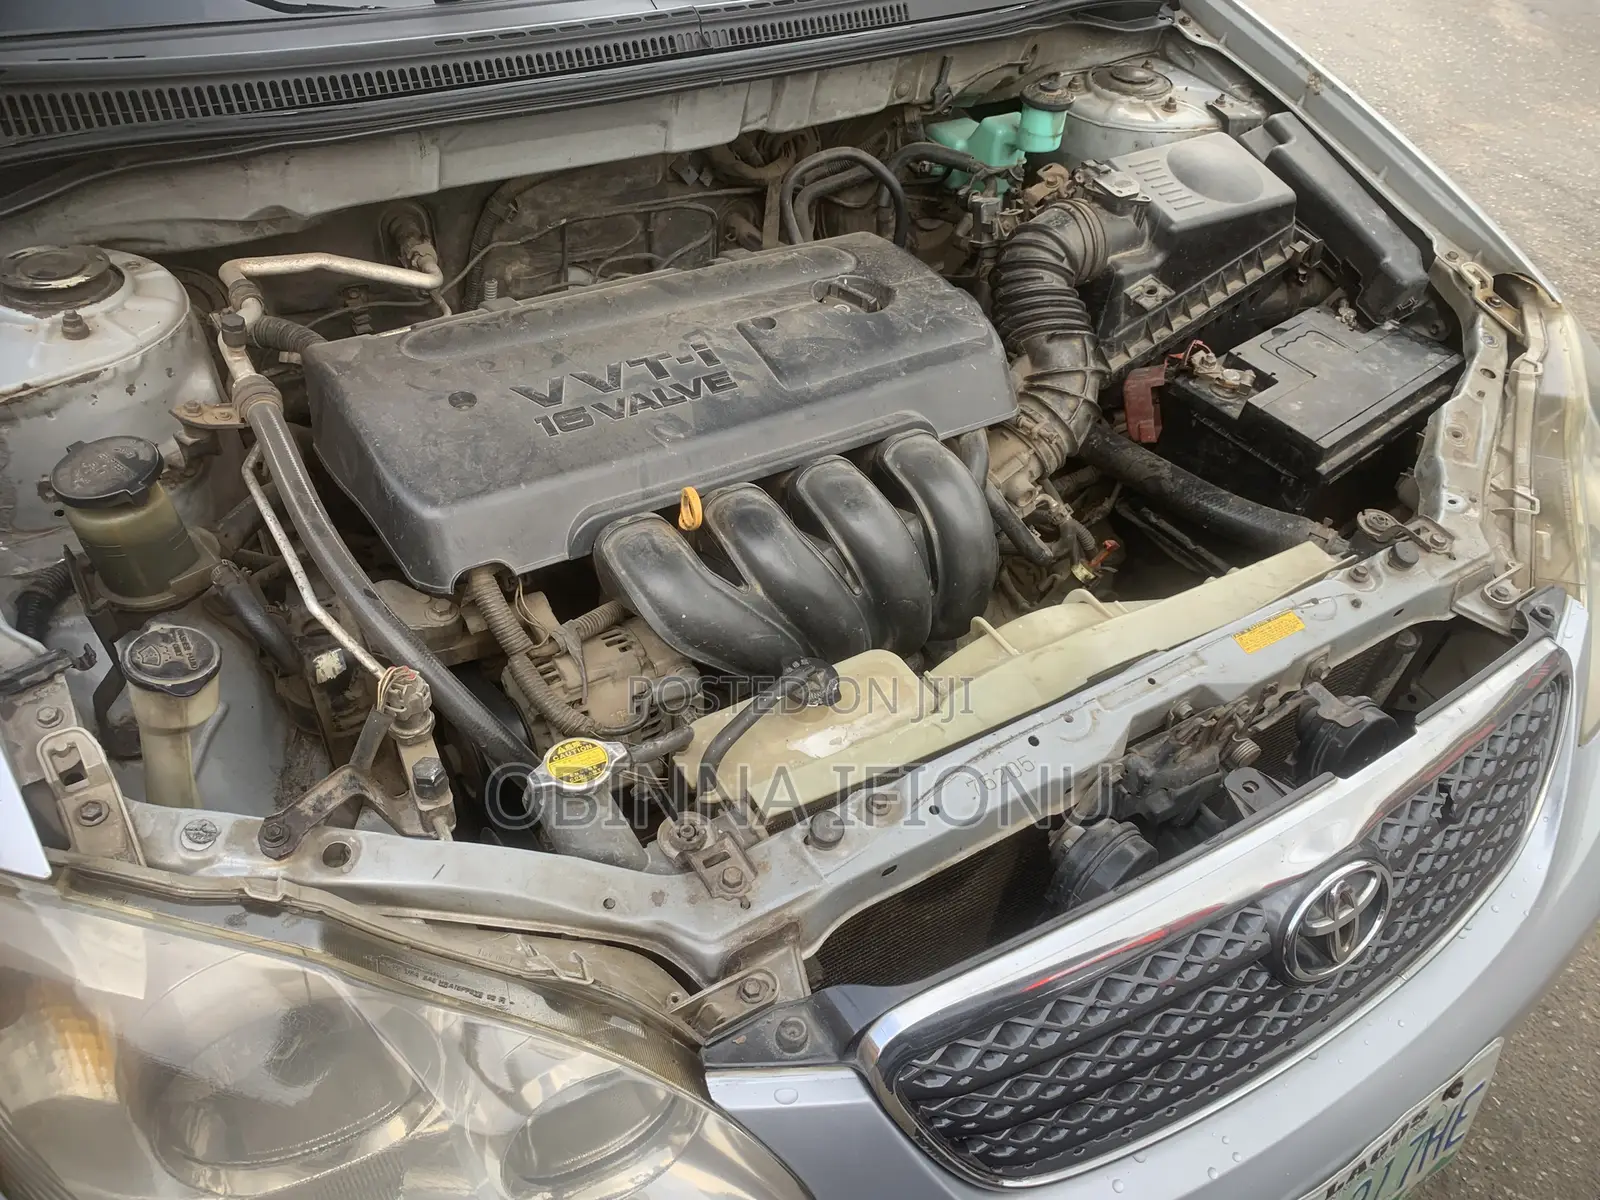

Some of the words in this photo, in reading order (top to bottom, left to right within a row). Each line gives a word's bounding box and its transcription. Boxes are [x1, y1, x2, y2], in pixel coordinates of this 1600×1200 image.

[509, 342, 722, 408] VVT-i
[533, 405, 596, 438] 16
[590, 370, 739, 421] VALVE
[552, 743, 593, 761] CAUTION
[1325, 1108, 1428, 1200] LAGOS
